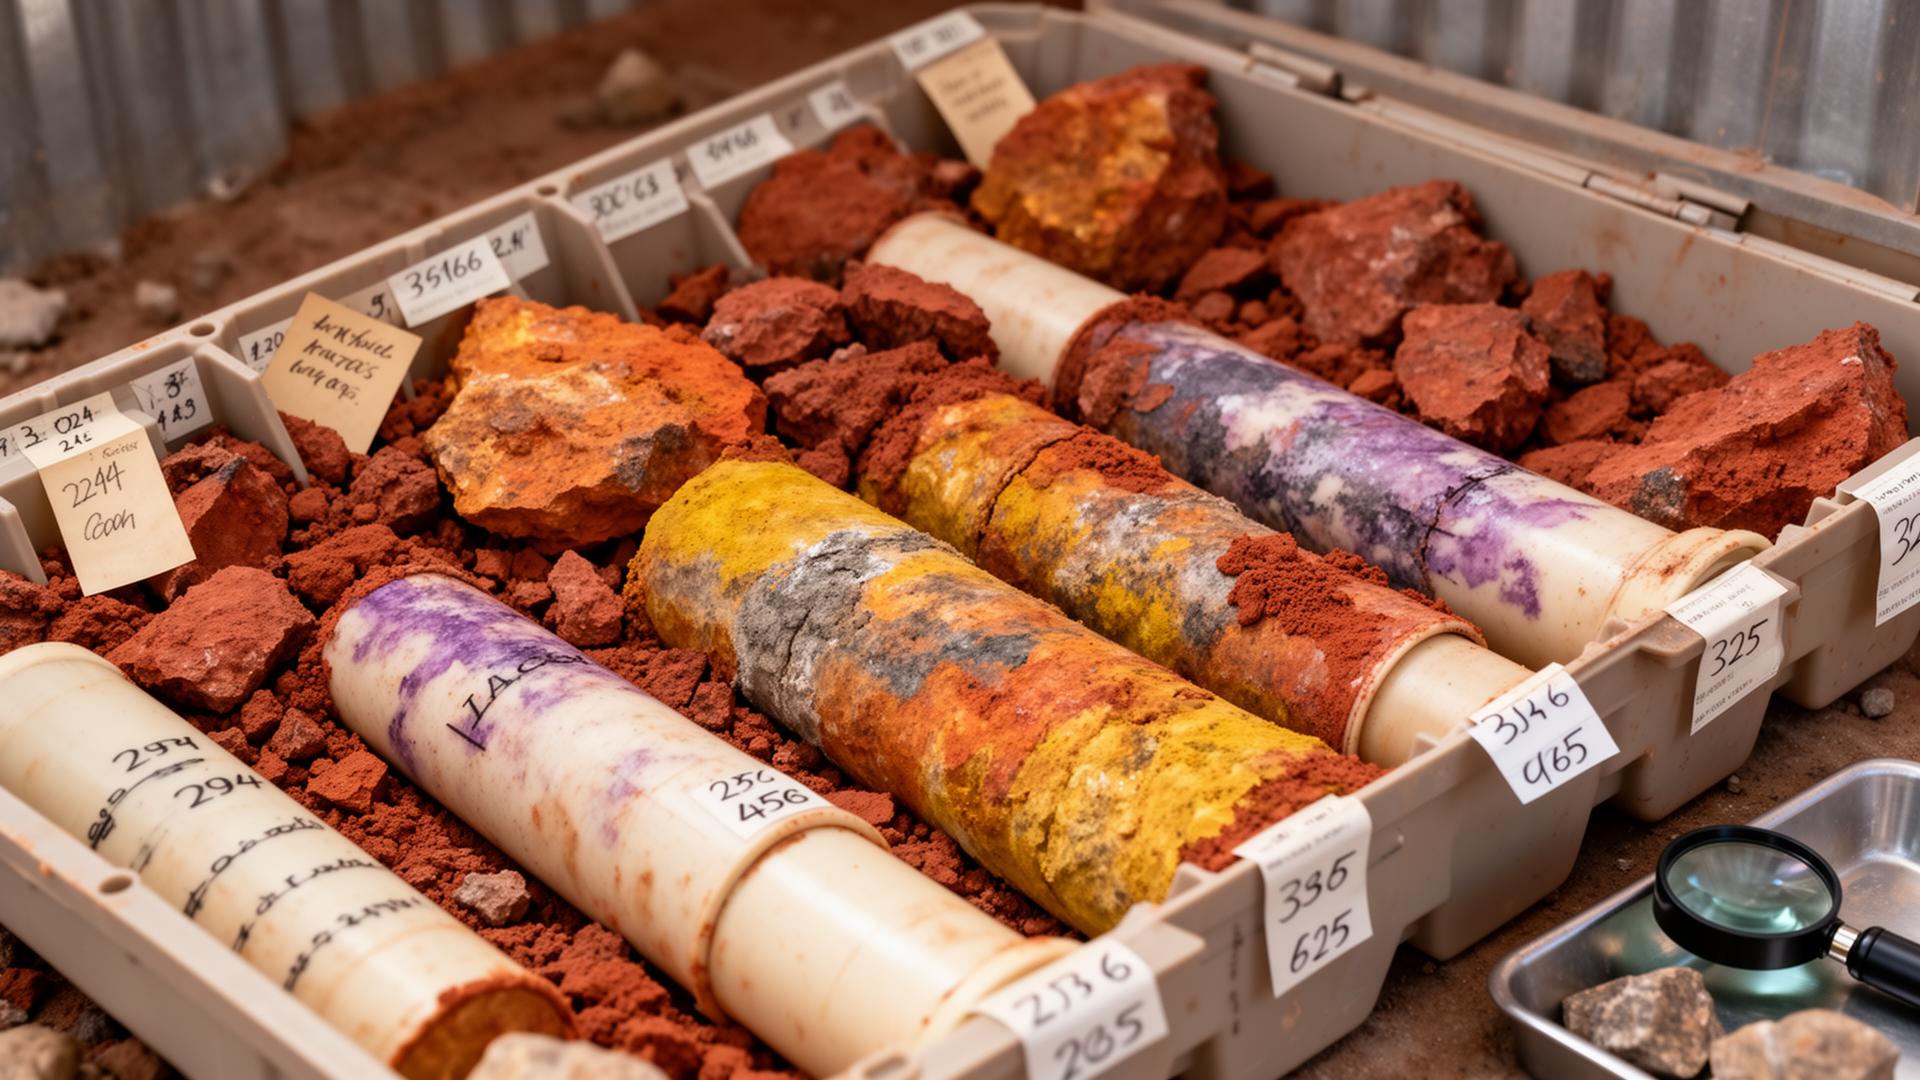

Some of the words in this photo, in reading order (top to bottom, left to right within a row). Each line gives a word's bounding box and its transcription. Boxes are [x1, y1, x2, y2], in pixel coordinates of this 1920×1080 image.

[1711, 617, 1769, 678] 325
[172, 773, 266, 810] 294
[738, 788, 809, 822] 456
[1290, 907, 1353, 974] 625
